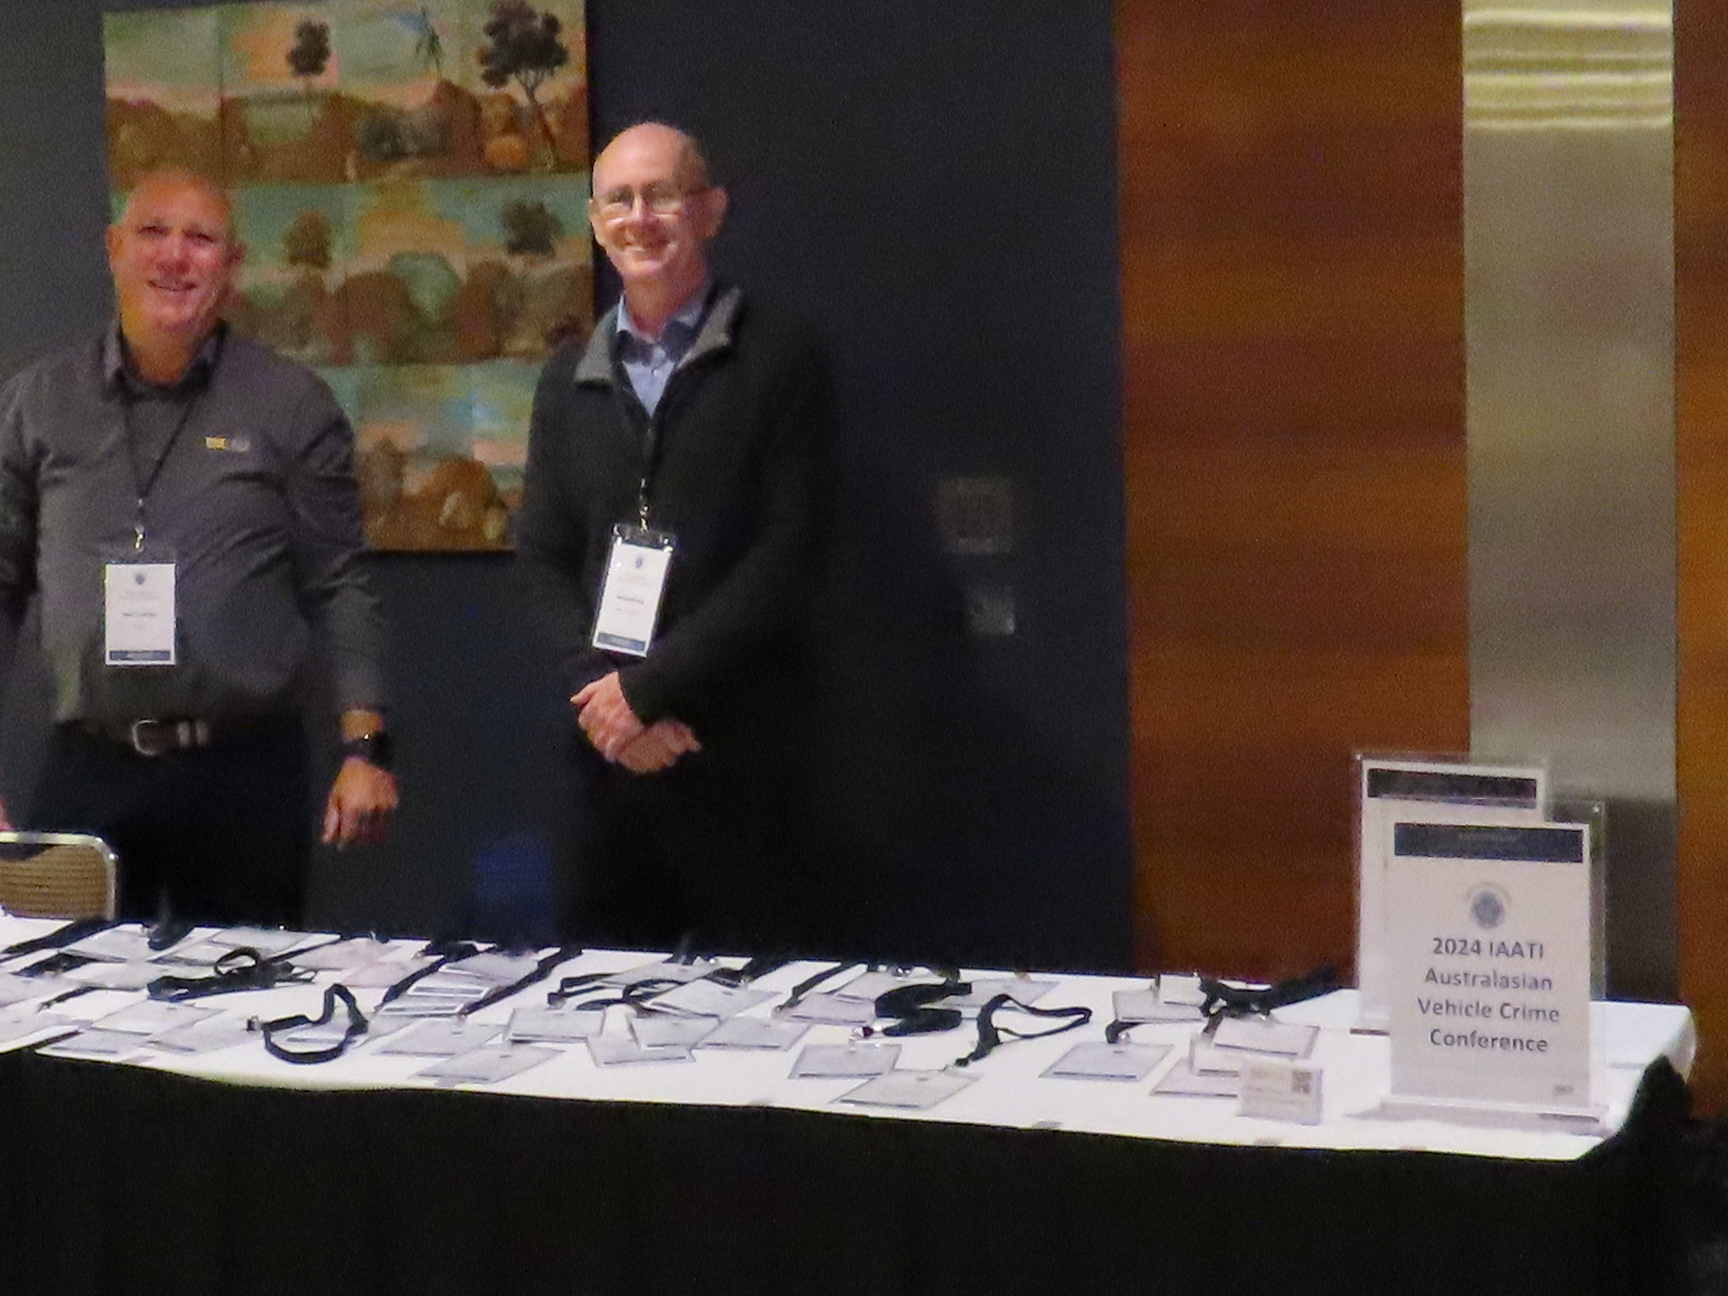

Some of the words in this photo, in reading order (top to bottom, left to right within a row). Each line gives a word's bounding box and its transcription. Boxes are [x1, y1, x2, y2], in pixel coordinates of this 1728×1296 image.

[1432, 937, 1482, 956] 2024
[1489, 941, 1544, 960] IAATI
[1425, 967, 1553, 991] Australasian
[1417, 997, 1492, 1019] Vehicle
[1500, 1002, 1561, 1023] Crime
[1430, 1028, 1549, 1053] Conference
